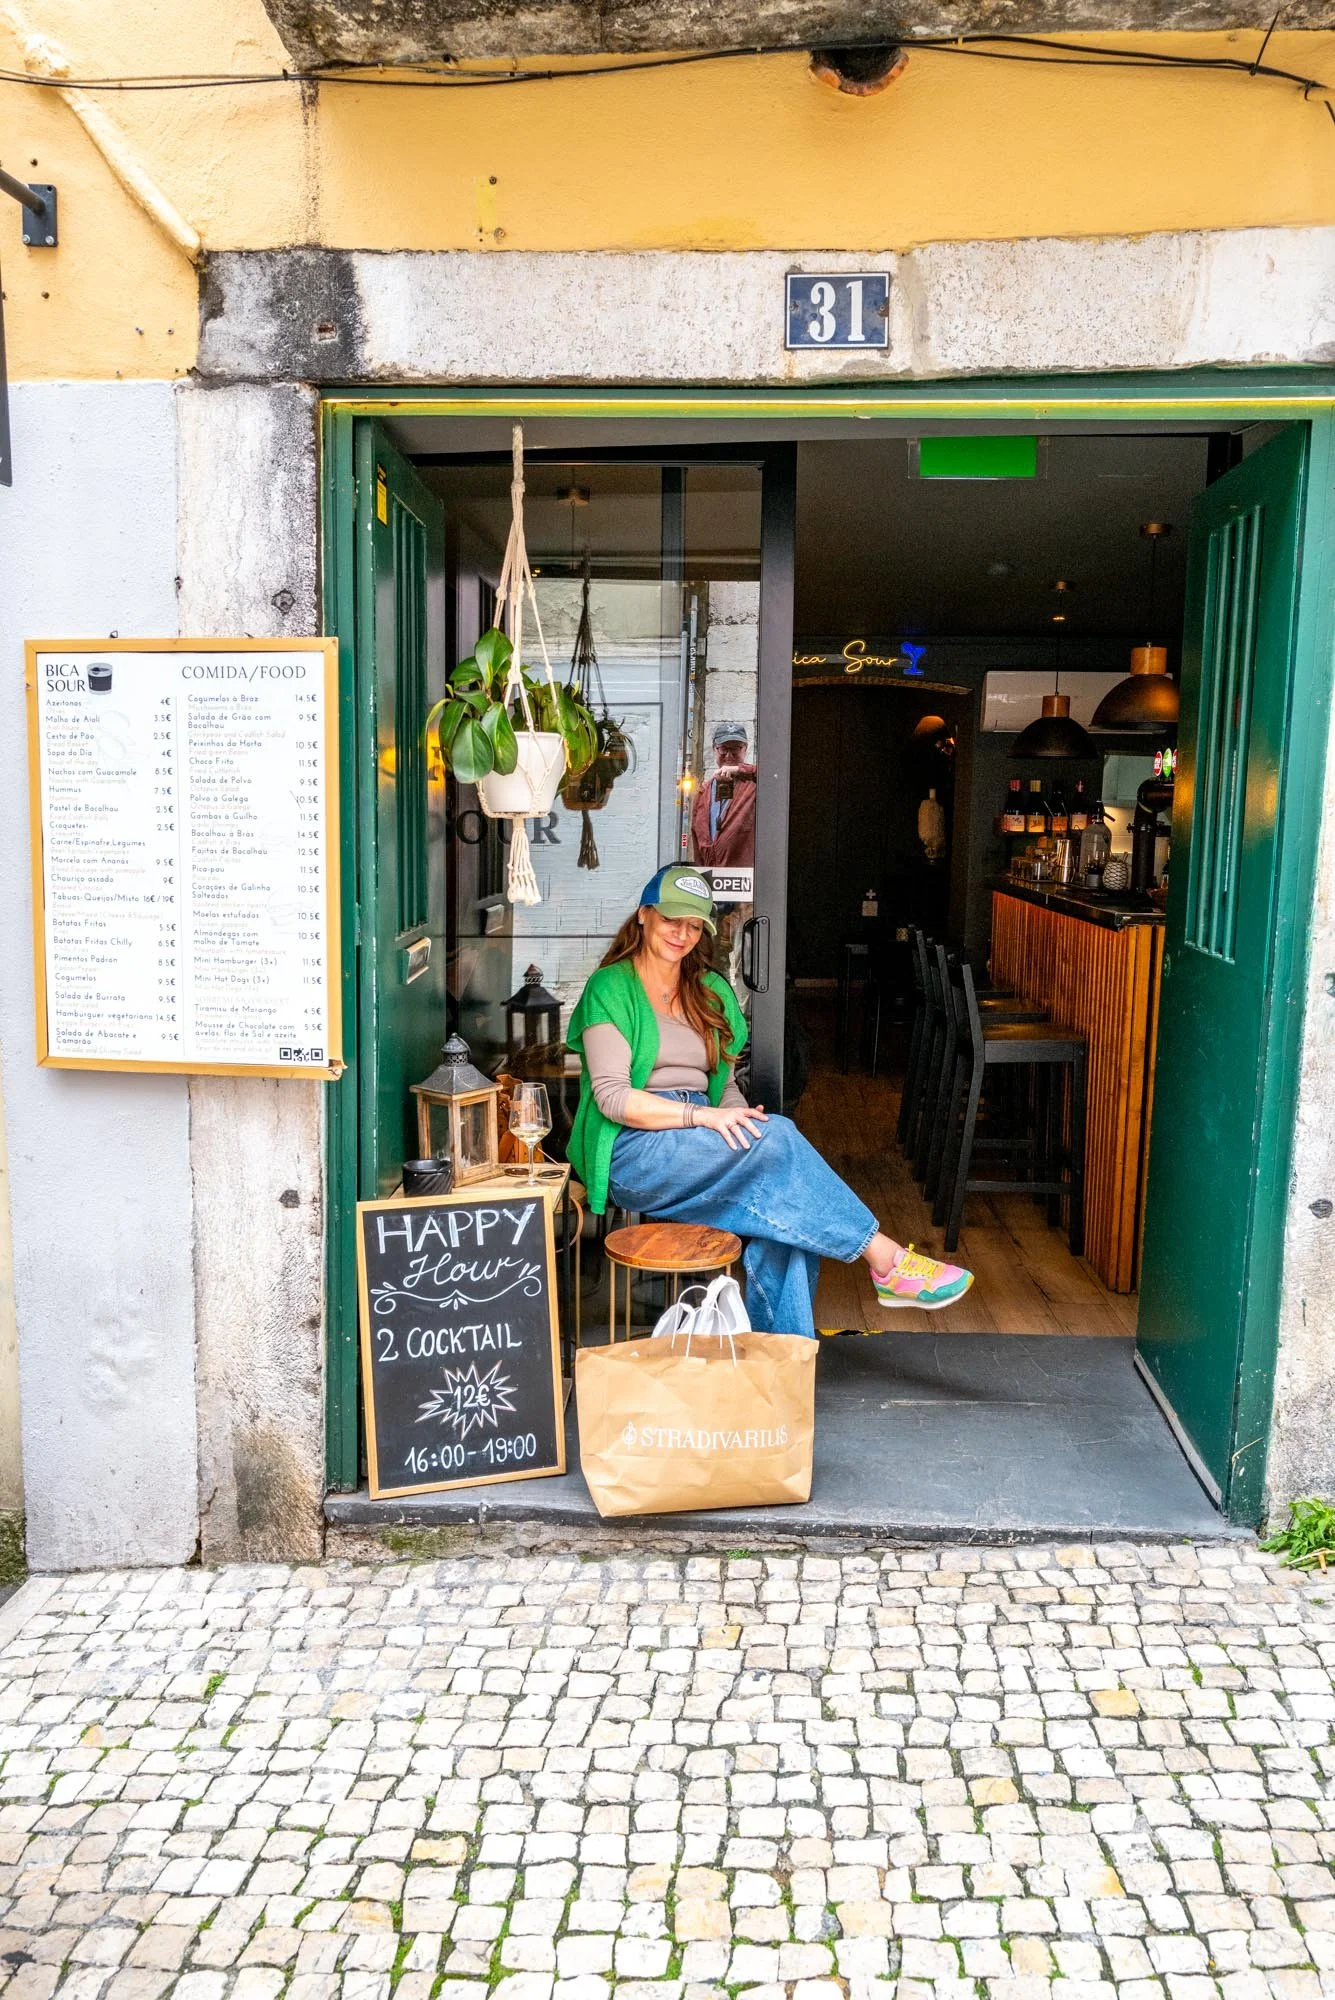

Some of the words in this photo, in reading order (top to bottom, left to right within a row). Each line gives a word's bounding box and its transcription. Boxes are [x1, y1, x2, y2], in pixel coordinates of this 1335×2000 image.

[808, 279, 866, 343] 31
[792, 651, 826, 665] ica
[842, 640, 898, 674] Sour
[45, 664, 79, 677] BICA
[182, 665, 306, 683] COMIDA/FOOD
[47, 679, 86, 692] SOUR
[160, 698, 171, 706] 4€
[188, 694, 229, 704] Cogumelos
[46, 715, 68, 723] Molho
[72, 715, 80, 723] de
[48, 748, 65, 756] Sopa
[80, 748, 92, 756] Dia
[161, 749, 172, 757] 4€
[222, 795, 248, 804] Galega
[85, 804, 119, 812] Bacalhau
[190, 812, 221, 820] Gambas
[233, 812, 257, 820] Guilho
[192, 829, 225, 837] Bacalhau
[192, 847, 217, 855] Fajitas
[233, 847, 268, 855] Bacalhau
[192, 865, 224, 874] Pica-pau
[51, 874, 85, 883] Chouriço
[163, 876, 174, 884] 9€
[229, 883, 238, 891] de
[712, 878, 750, 891] OPEN
[192, 891, 228, 899] Salteados
[53, 919, 81, 927] Batatas
[85, 919, 106, 927] Fritas
[85, 937, 107, 945] Fritas
[111, 938, 132, 948] Chilly
[54, 954, 88, 962] Pimentos
[214, 957, 257, 966] Hamburger
[55, 973, 96, 982] Cogumelos
[231, 976, 249, 984] Dogs
[55, 992, 81, 1000] Salada
[97, 993, 125, 1001] Burrata
[56, 1009, 104, 1019] Hamburguer
[195, 1021, 223, 1029] Mousse
[56, 1029, 82, 1037] Salada
[85, 1029, 93, 1037] de
[98, 1030, 129, 1039] Abacate
[377, 1203, 537, 1254] HAPPY
[403, 1252, 524, 1289] Hour
[377, 1329, 399, 1362] 2
[406, 1323, 522, 1359] COCKTAIL
[453, 1384, 492, 1411] 12€
[640, 1423, 789, 1450] STRADIVARIUS
